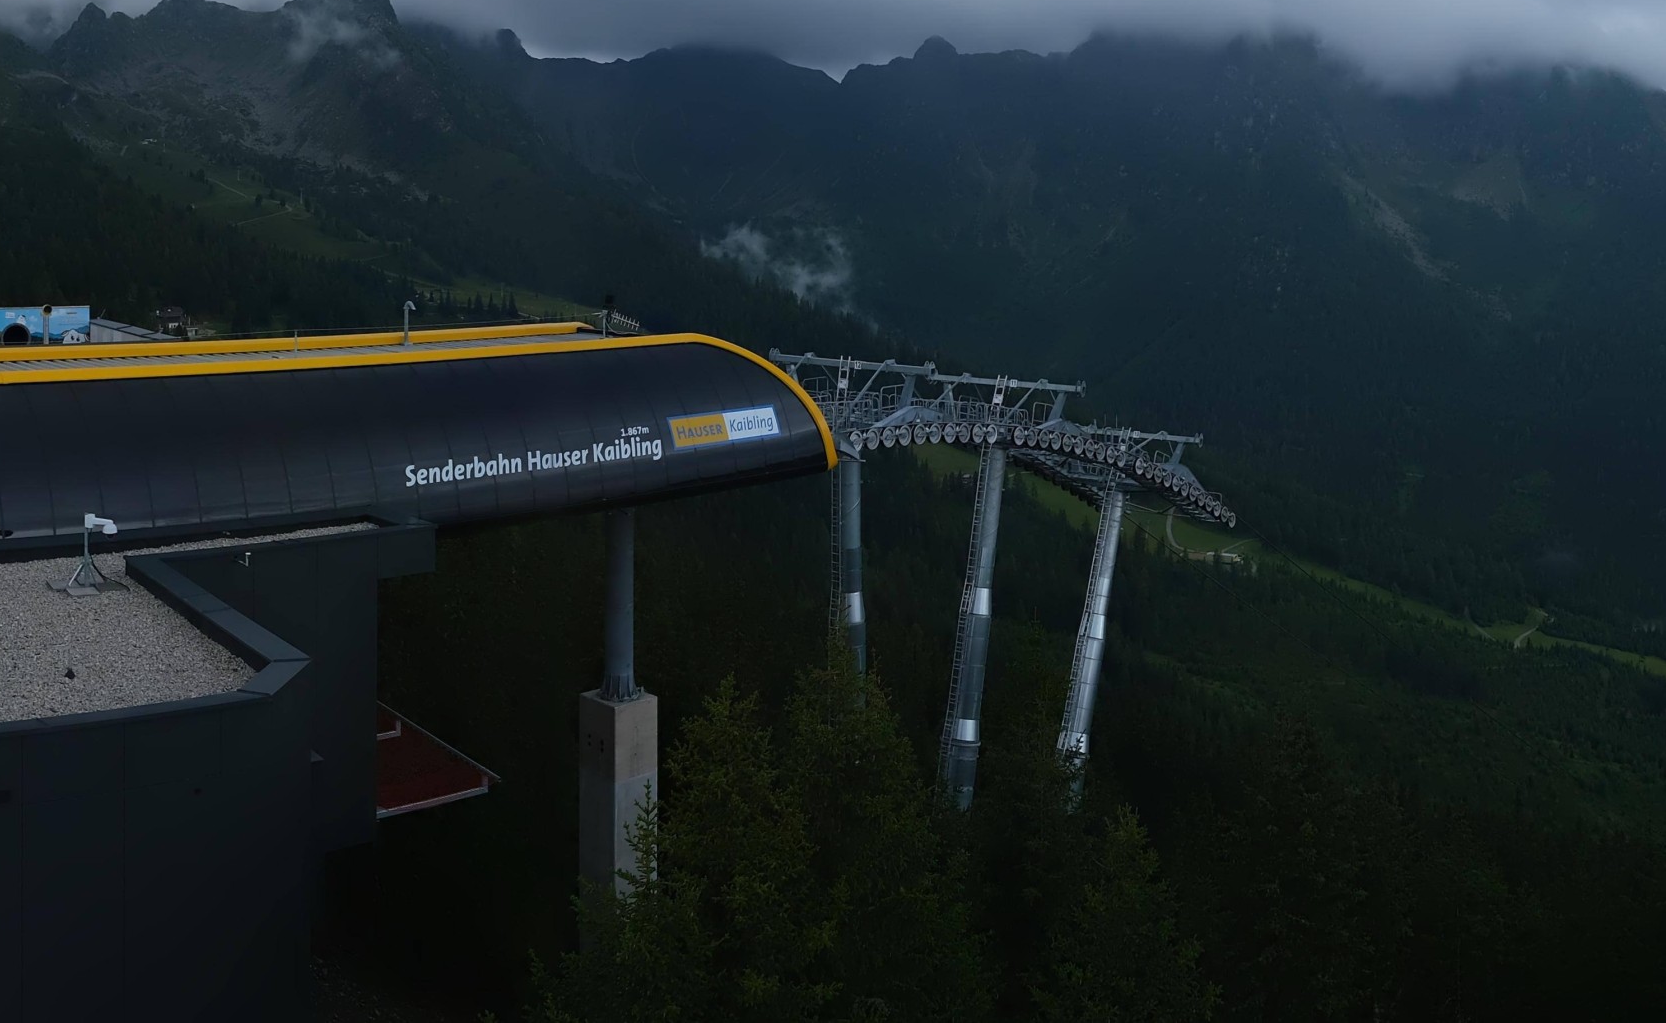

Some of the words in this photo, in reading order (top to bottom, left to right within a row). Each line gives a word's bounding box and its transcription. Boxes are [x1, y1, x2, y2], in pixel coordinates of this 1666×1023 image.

[620, 426, 650, 436] 1.867m
[676, 423, 723, 440] HAUSER
[729, 414, 774, 433] Kaibling
[405, 452, 522, 487] Senderbahn
[527, 446, 588, 471] Hauser
[593, 437, 663, 463] Kaibling
